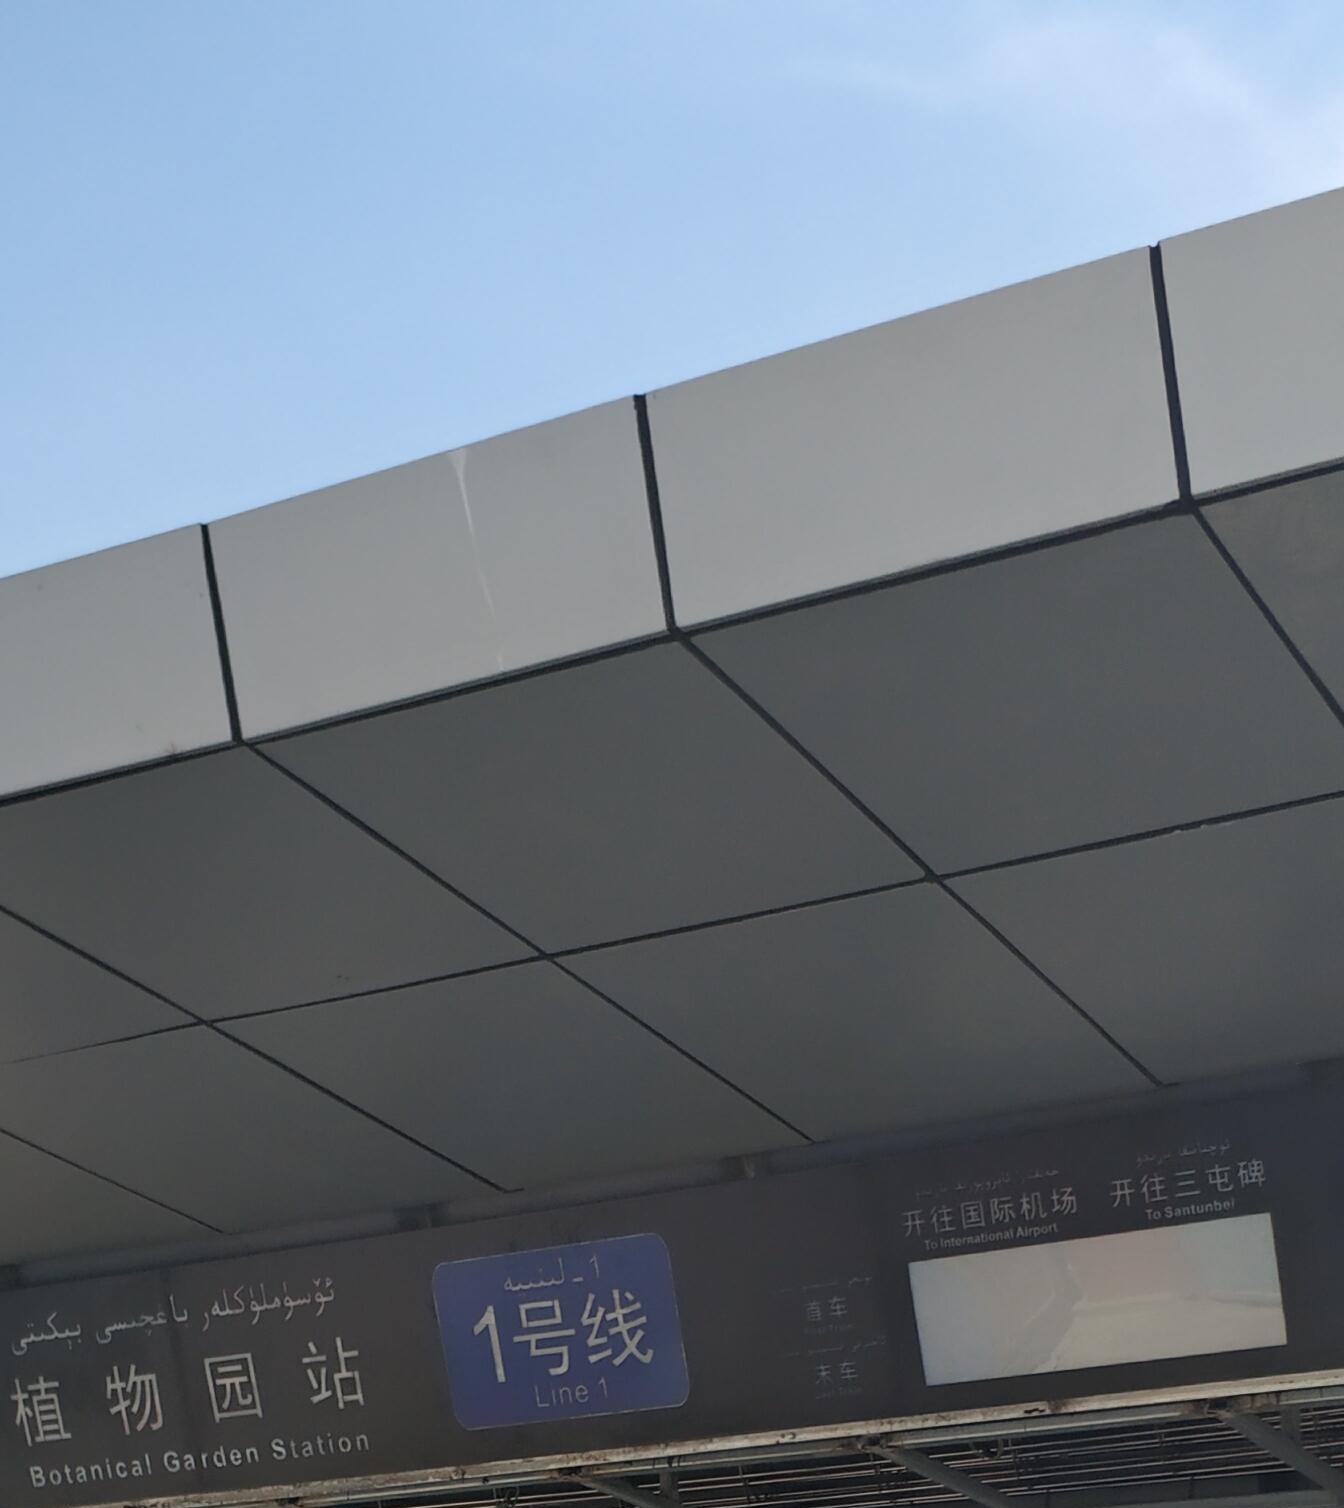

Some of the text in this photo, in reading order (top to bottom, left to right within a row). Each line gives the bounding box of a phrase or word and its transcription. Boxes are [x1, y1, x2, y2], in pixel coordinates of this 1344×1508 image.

[1110, 1158, 1266, 1207] 开往三屯碑
[903, 1187, 1077, 1237] 开往国际机场
[1145, 1198, 1235, 1220] To Santunbei
[924, 1223, 1059, 1250] To International Airport
[473, 1289, 654, 1383] 1号线
[11, 1336, 366, 1447] 植物园站
[534, 1376, 608, 1408] Line 1
[30, 1433, 370, 1488] Botanical Garden Station
